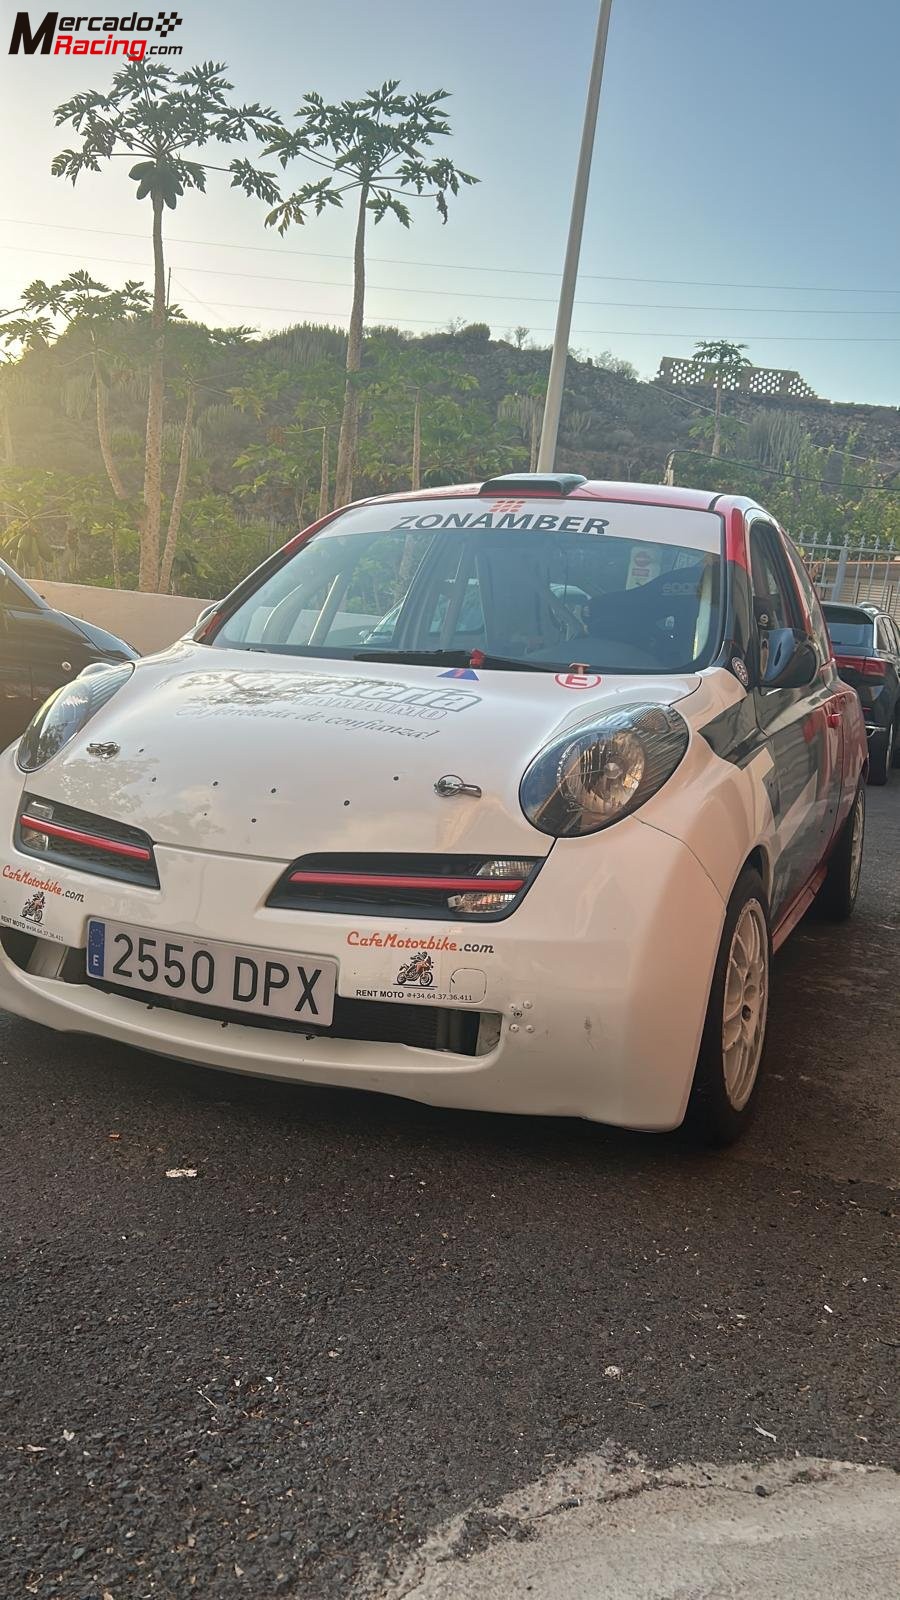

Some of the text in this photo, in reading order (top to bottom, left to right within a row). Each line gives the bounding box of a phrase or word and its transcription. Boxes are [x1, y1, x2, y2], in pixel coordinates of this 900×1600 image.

[390, 512, 609, 535] ZONAMBER
[295, 711, 325, 722] de
[325, 717, 440, 740] confianza!
[2, 865, 84, 903] CafeMotorbike.com
[13, 919, 25, 929] MOTO
[347, 931, 494, 953] CafeMotorbike.com
[93, 954, 99, 966] E
[112, 934, 322, 1015] 2550 DPX
[356, 989, 378, 997] RENT
[379, 990, 404, 999] MOTO
